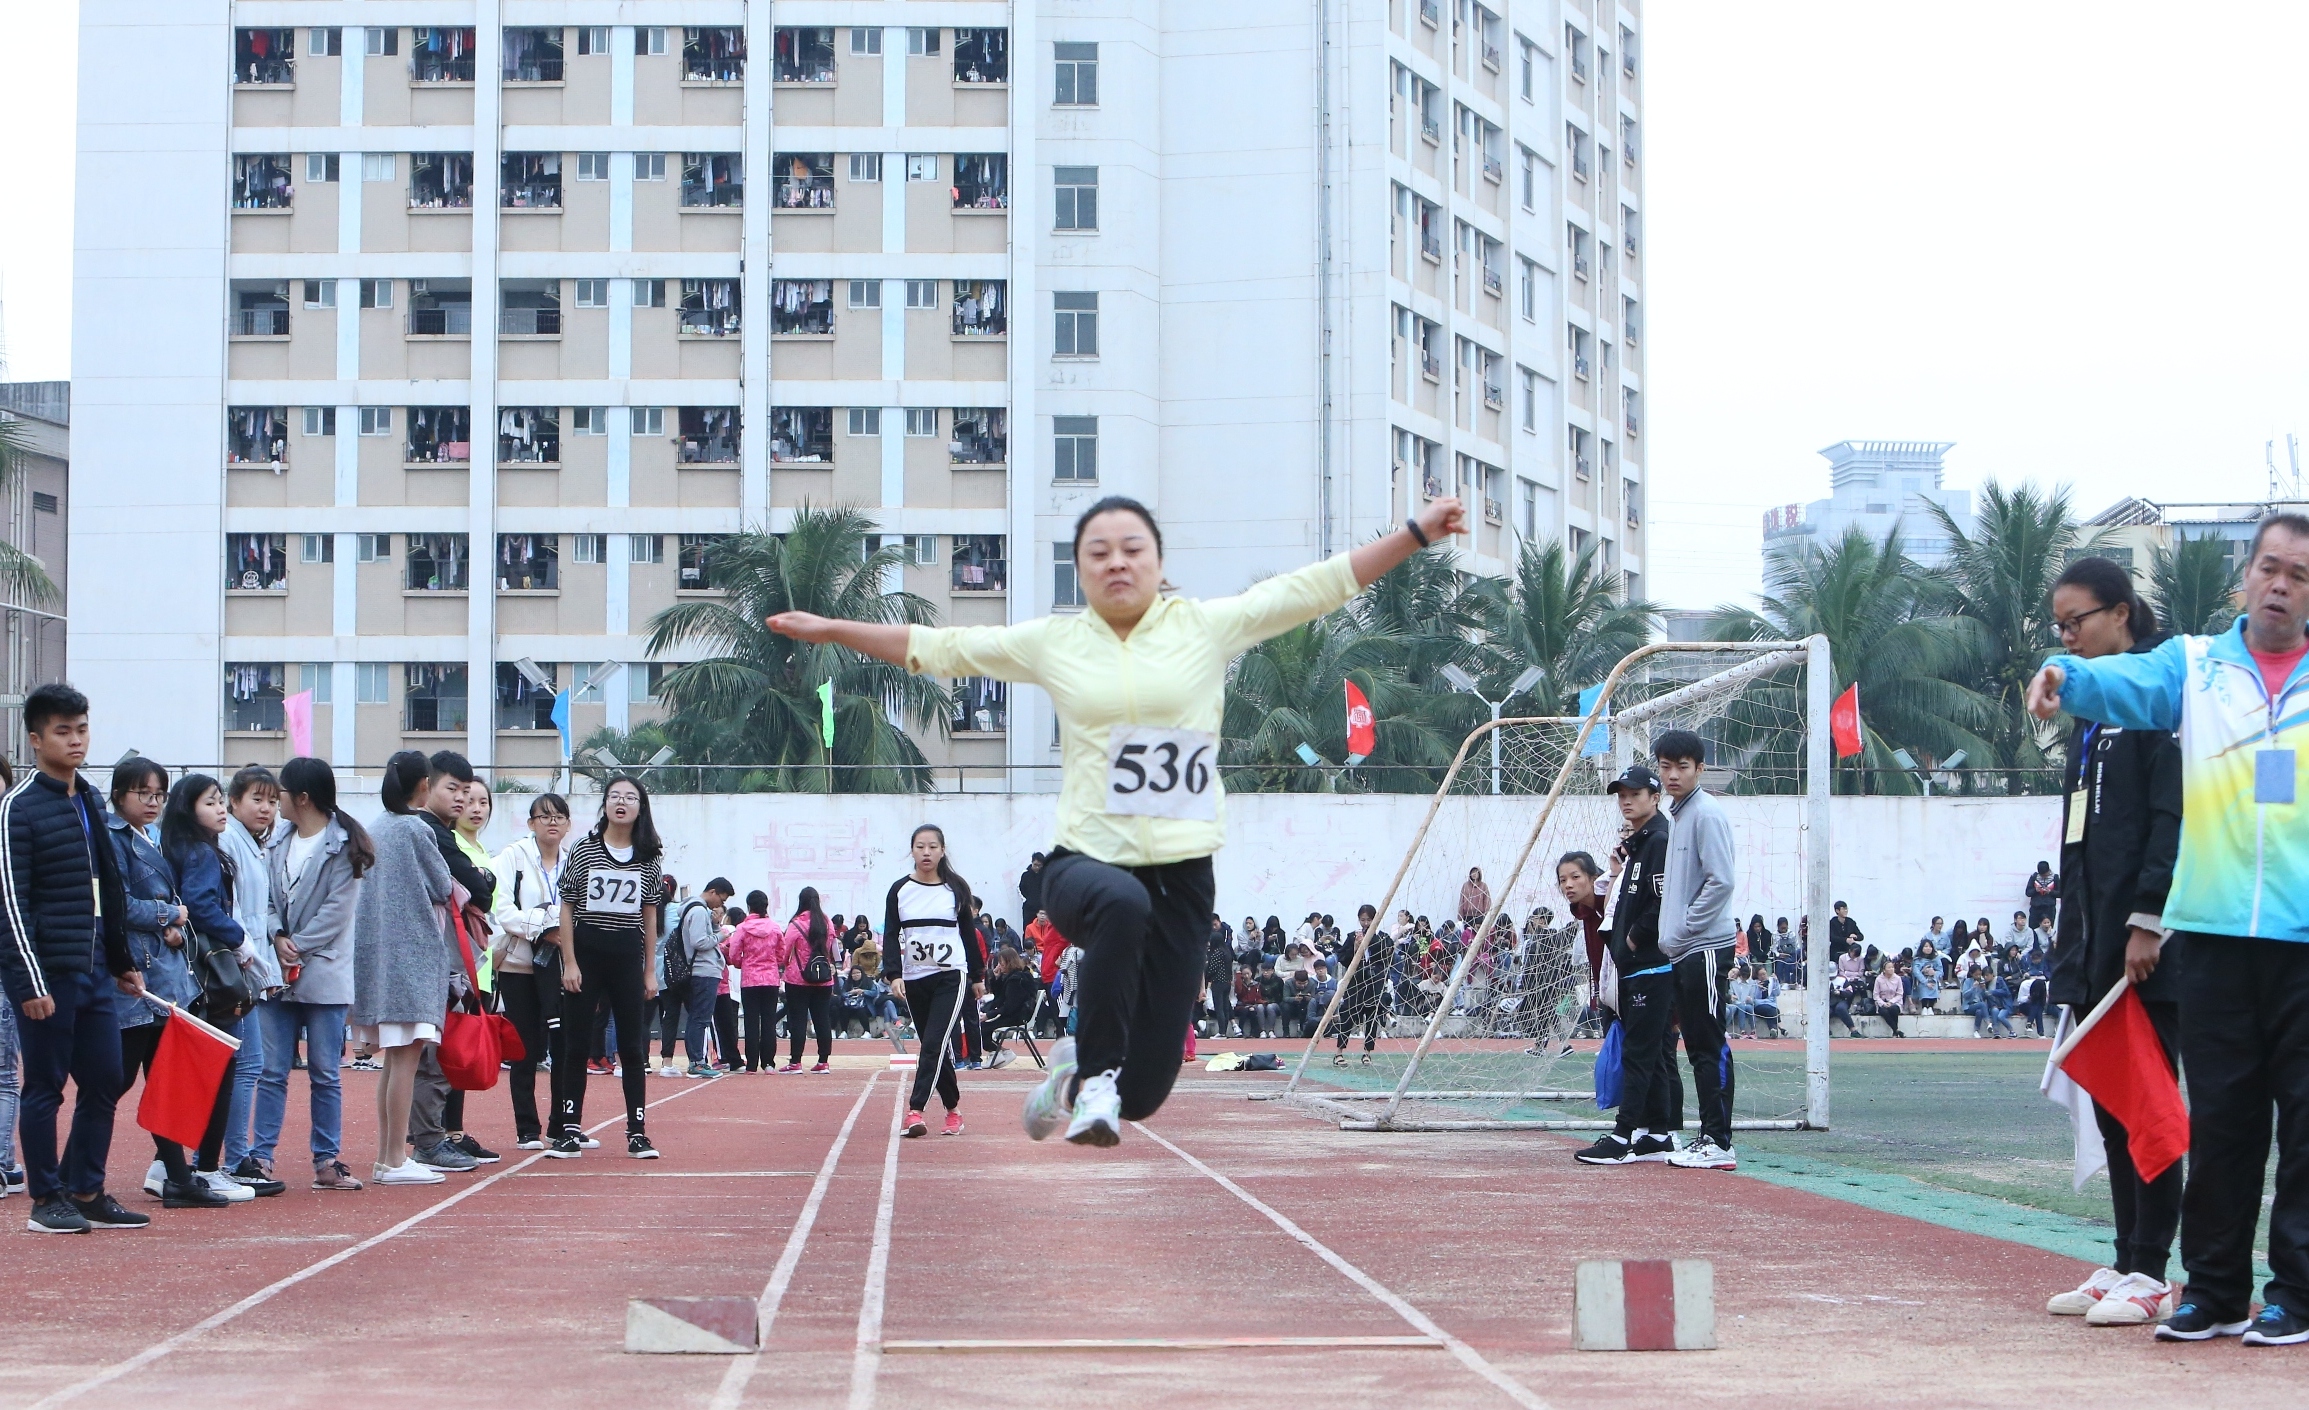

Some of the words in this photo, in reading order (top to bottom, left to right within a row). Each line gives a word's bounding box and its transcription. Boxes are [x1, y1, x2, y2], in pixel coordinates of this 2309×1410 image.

[1113, 742, 1210, 795] 536
[589, 876, 637, 904] 372
[910, 940, 953, 968] 312
